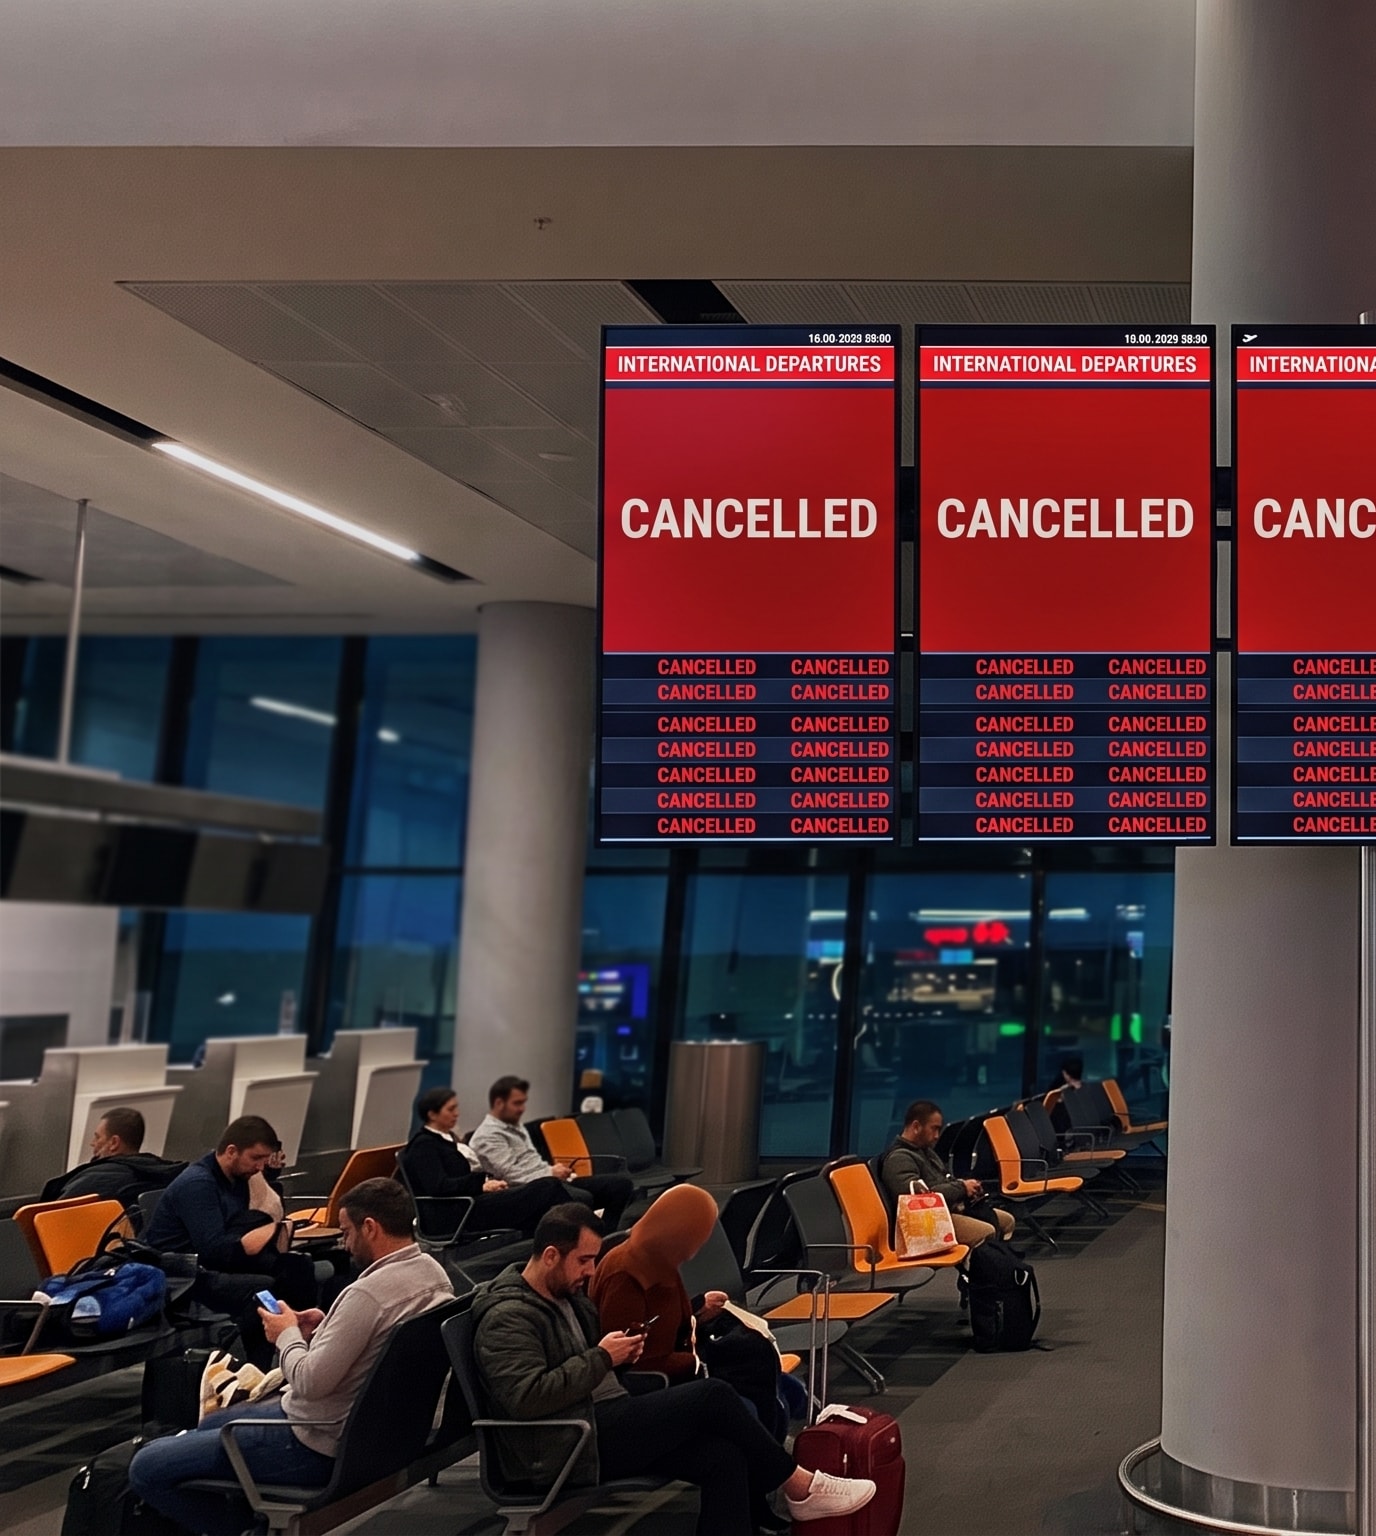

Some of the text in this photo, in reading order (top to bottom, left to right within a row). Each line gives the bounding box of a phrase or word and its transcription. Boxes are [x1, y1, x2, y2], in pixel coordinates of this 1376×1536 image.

[618, 355, 881, 373] INTERNATIONAL DEPARTURES
[933, 355, 1197, 373] INTERNATIONAL DEPARTURES
[621, 498, 878, 539] CANCELLED
[937, 497, 1194, 539] CANCELLED
[657, 658, 890, 675] CANCELLED CANCELLED
[975, 658, 1207, 675] CANCELLED CANCELLED
[657, 684, 890, 701] CANCELLED CANCELLED
[975, 683, 1207, 700] CANCELLED CANCELLED
[657, 716, 890, 733] CANCELLED CANCELLED
[975, 716, 1207, 733] CANCELLED CANCELLED
[657, 741, 890, 758] CANCELLED CANCELLED
[975, 741, 1207, 758] CANCELLED CANCELLED
[657, 766, 890, 783] CANCELLED CANCELLED
[975, 766, 1207, 783] CANCELLED CANCELLED
[657, 792, 890, 809] CANCELLED CANCELLED
[975, 791, 1207, 808] CANCELLED CANCELLED
[657, 817, 889, 834] CANCELLED CANCELLED
[975, 816, 1207, 833] CANCELLED CANCELLED
